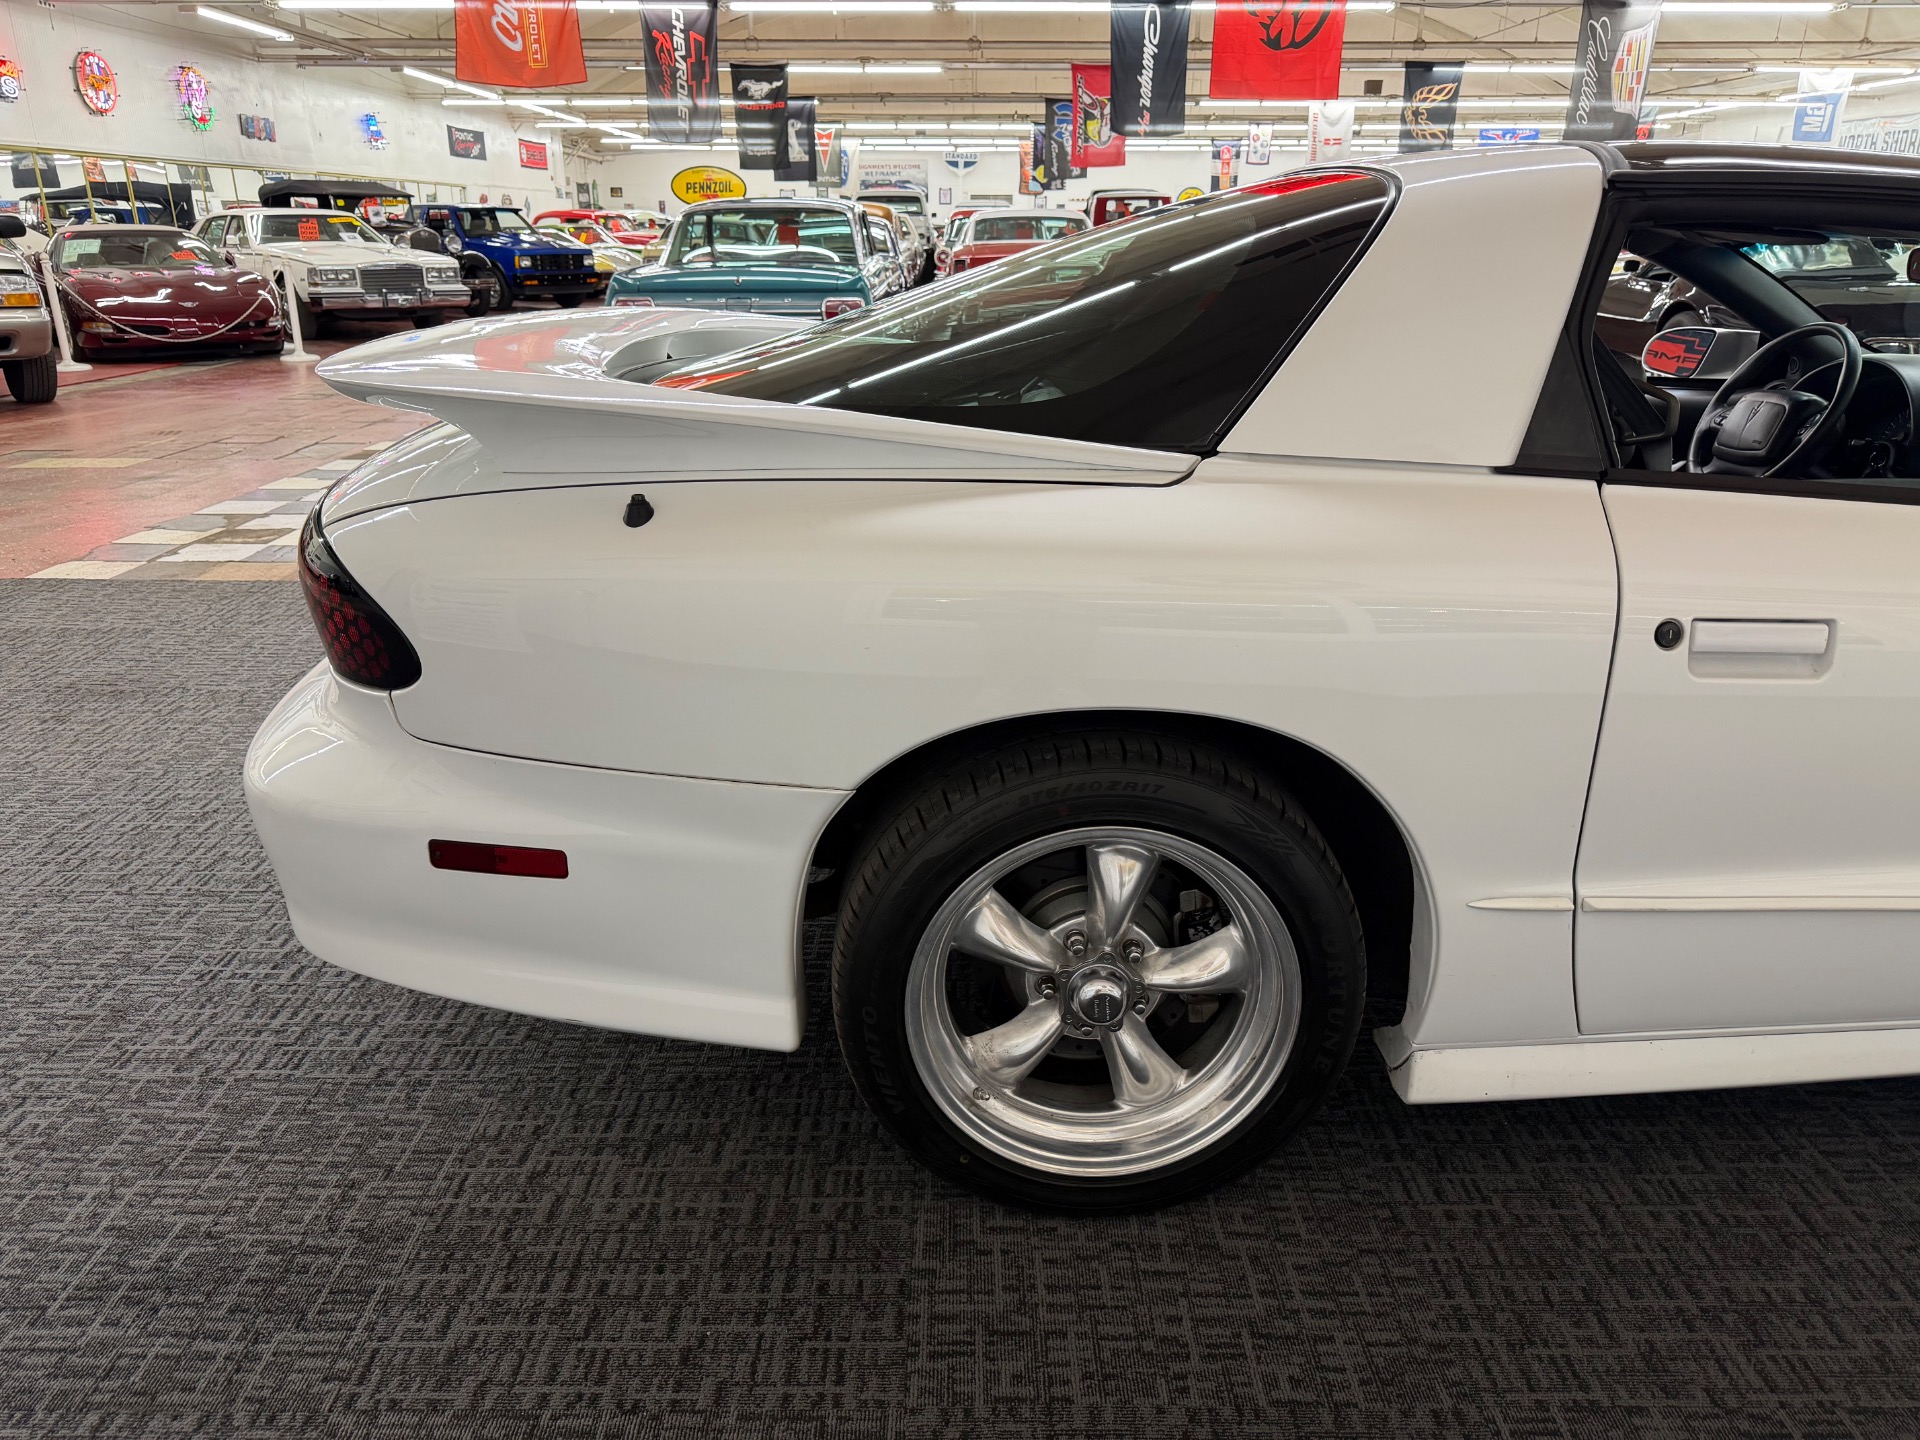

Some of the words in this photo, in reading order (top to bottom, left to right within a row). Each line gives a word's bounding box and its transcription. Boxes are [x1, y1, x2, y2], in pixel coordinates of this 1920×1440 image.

[651, 29, 676, 101] Racing
[671, 6, 689, 134] CHEVROLET
[1137, 3, 1161, 108] Charger
[1576, 16, 1611, 125] Cadillac
[737, 101, 786, 111] MUSTANG
[685, 181, 734, 194] PENNZOIL
[945, 152, 978, 160] STANDARD
